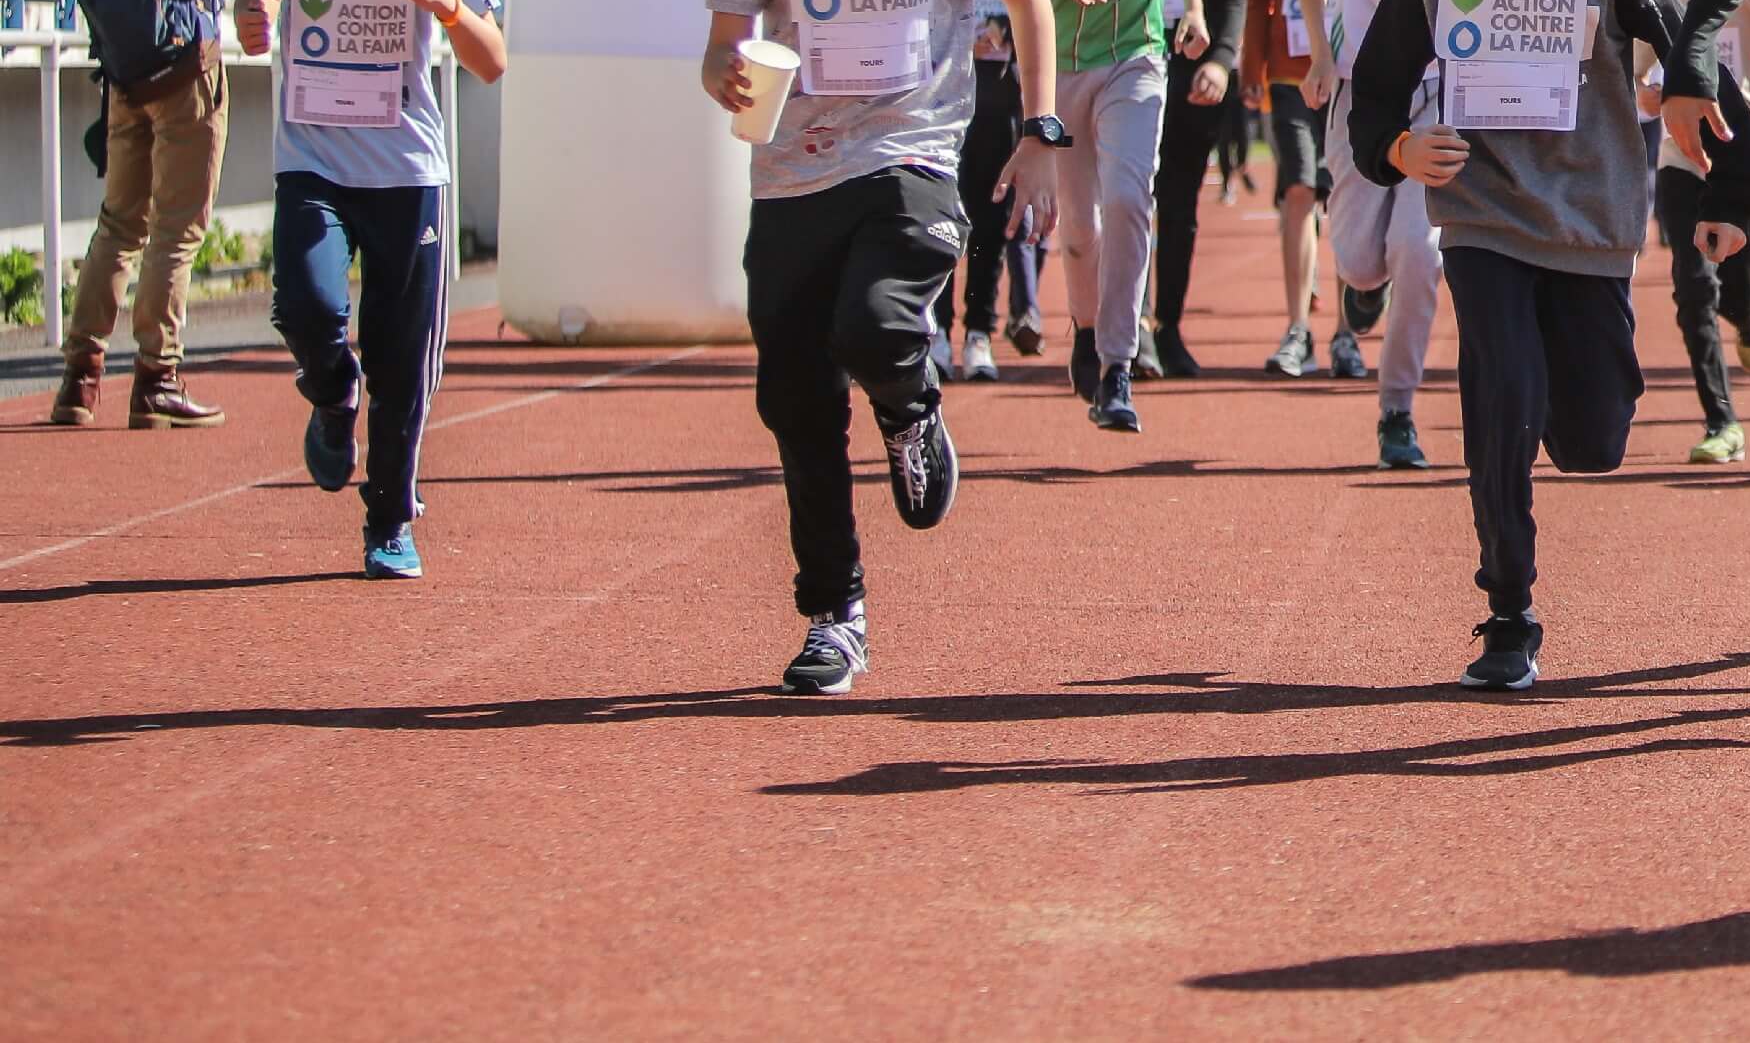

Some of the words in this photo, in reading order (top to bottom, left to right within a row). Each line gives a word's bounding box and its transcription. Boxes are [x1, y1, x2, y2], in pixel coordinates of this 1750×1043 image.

[338, 4, 407, 20] ACTION
[337, 22, 406, 36] CONTRE
[1490, 14, 1574, 34] CONTRE
[337, 39, 358, 53] LA
[362, 38, 406, 54] FAIM
[1490, 33, 1515, 52] LA
[1520, 34, 1573, 54] FAIM
[859, 59, 884, 67] TOURS
